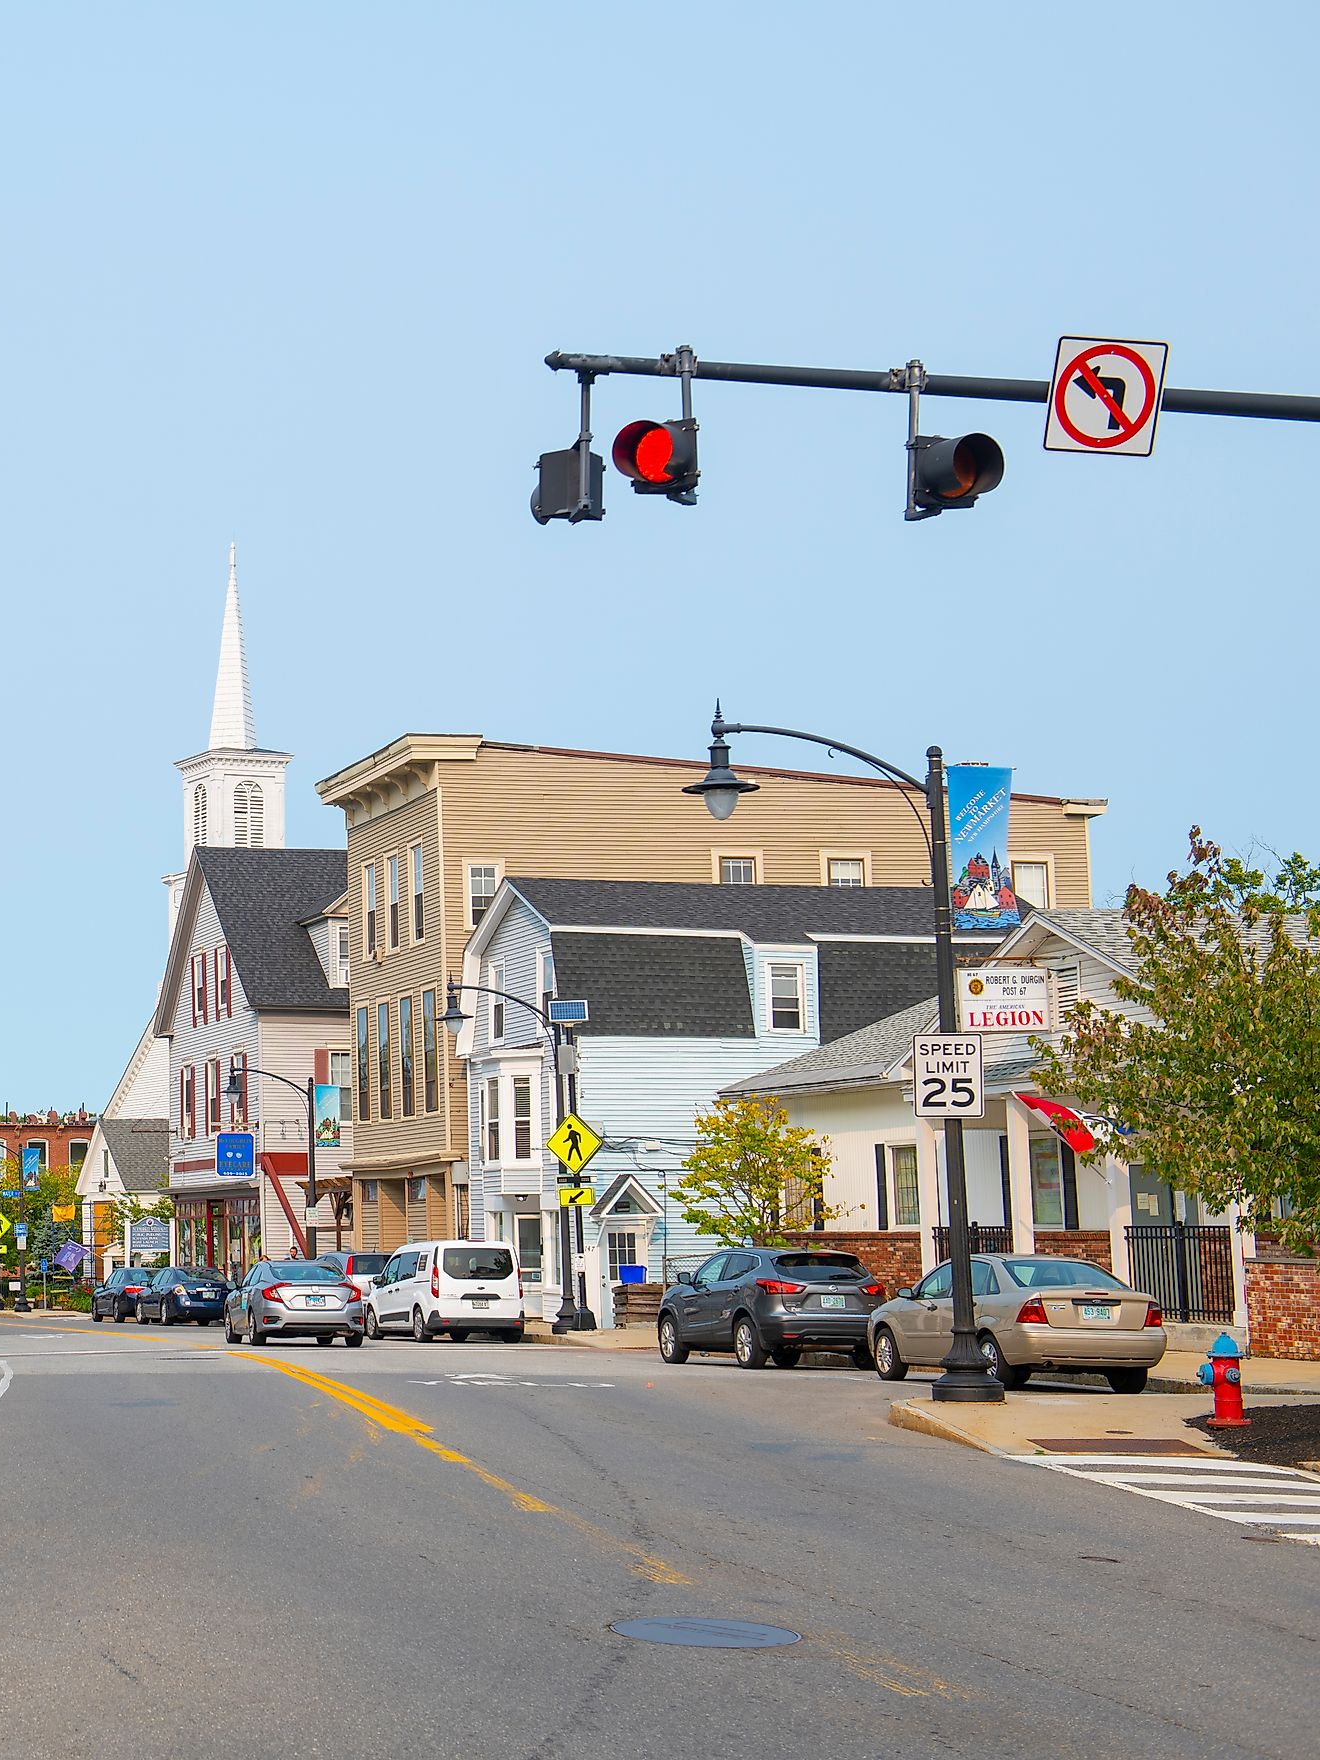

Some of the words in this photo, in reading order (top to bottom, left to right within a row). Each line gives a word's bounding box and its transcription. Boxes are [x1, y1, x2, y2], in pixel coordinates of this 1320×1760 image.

[955, 789, 986, 821] WELCOME
[969, 806, 979, 816] TO
[954, 787, 1007, 844] NEWMARKET
[985, 976, 1010, 985] ROBERT
[1020, 975, 1045, 985] DURGIN
[1002, 987, 1017, 996] POST
[1019, 987, 1027, 996] 67
[969, 1010, 1044, 1027] LEGION
[919, 1043, 976, 1056] SPEED
[925, 1061, 970, 1073] LIMIT
[922, 1077, 975, 1108] 25
